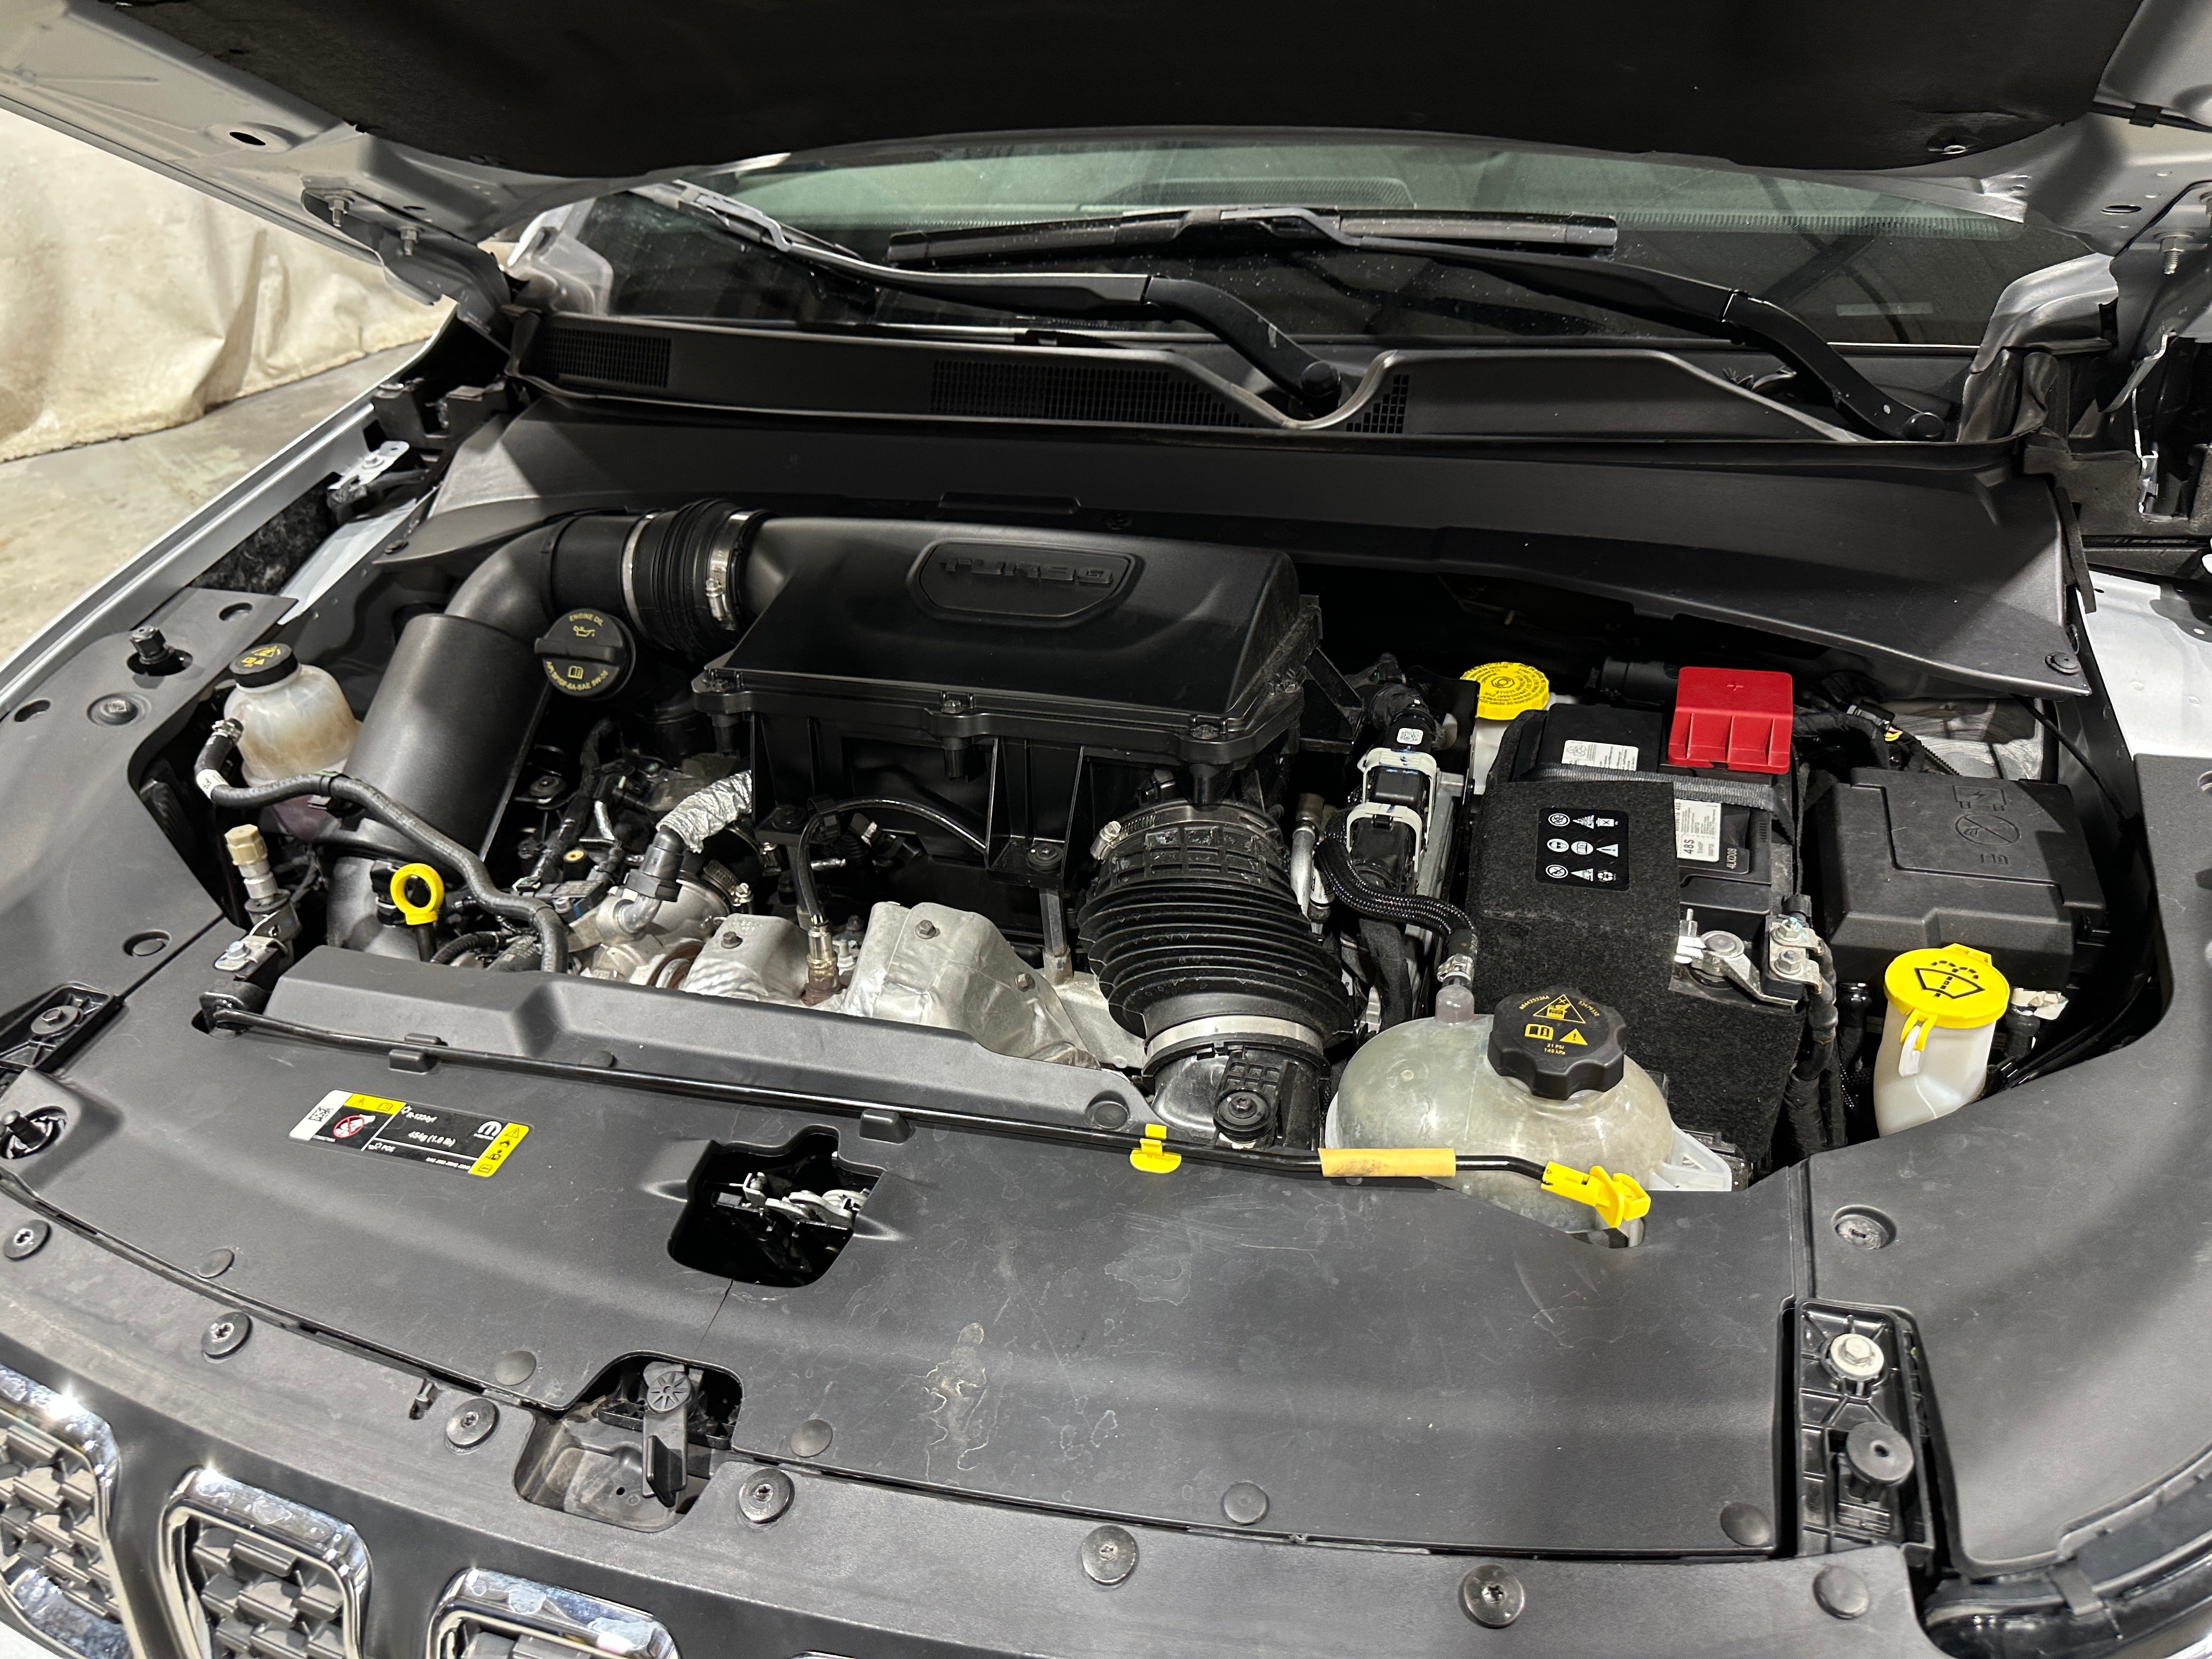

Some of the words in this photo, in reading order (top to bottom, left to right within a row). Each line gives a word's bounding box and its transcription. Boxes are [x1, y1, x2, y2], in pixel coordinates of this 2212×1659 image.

[939, 558, 1114, 585] TURBO
[569, 613, 594, 621] ENGINE
[594, 616, 603, 627] OIL
[1683, 839, 1695, 854] 48S
[408, 1131, 428, 1142] 454g
[427, 1135, 444, 1143] (1.0
[443, 1137, 456, 1147] lb)
[381, 1144, 396, 1152] POE
